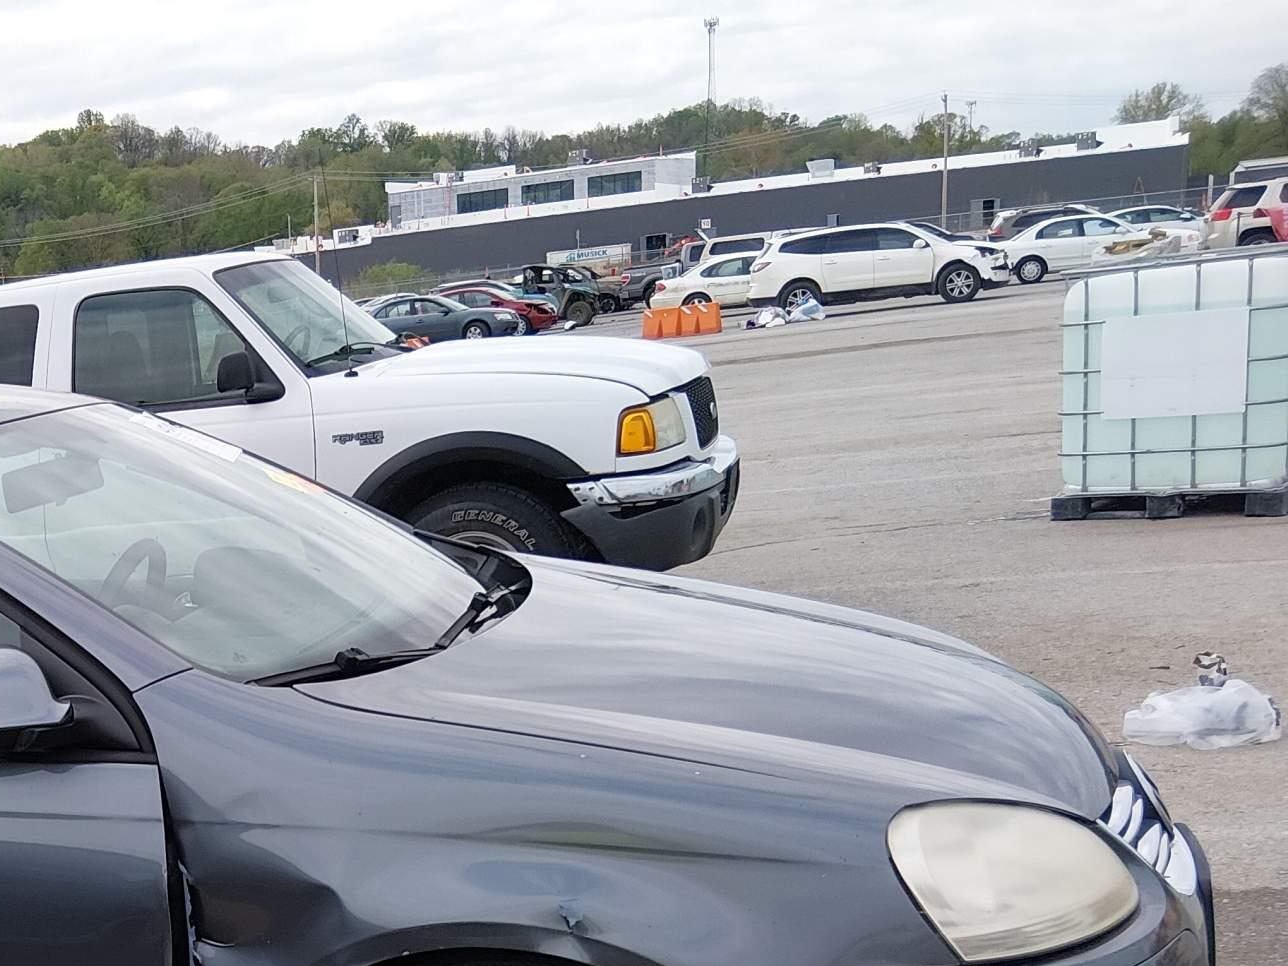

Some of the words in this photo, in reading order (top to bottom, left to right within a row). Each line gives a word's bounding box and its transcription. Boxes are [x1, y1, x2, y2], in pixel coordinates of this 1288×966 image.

[577, 249, 608, 259] MUSICK
[331, 430, 384, 445] RANGER
[452, 510, 537, 551] GENERAL
